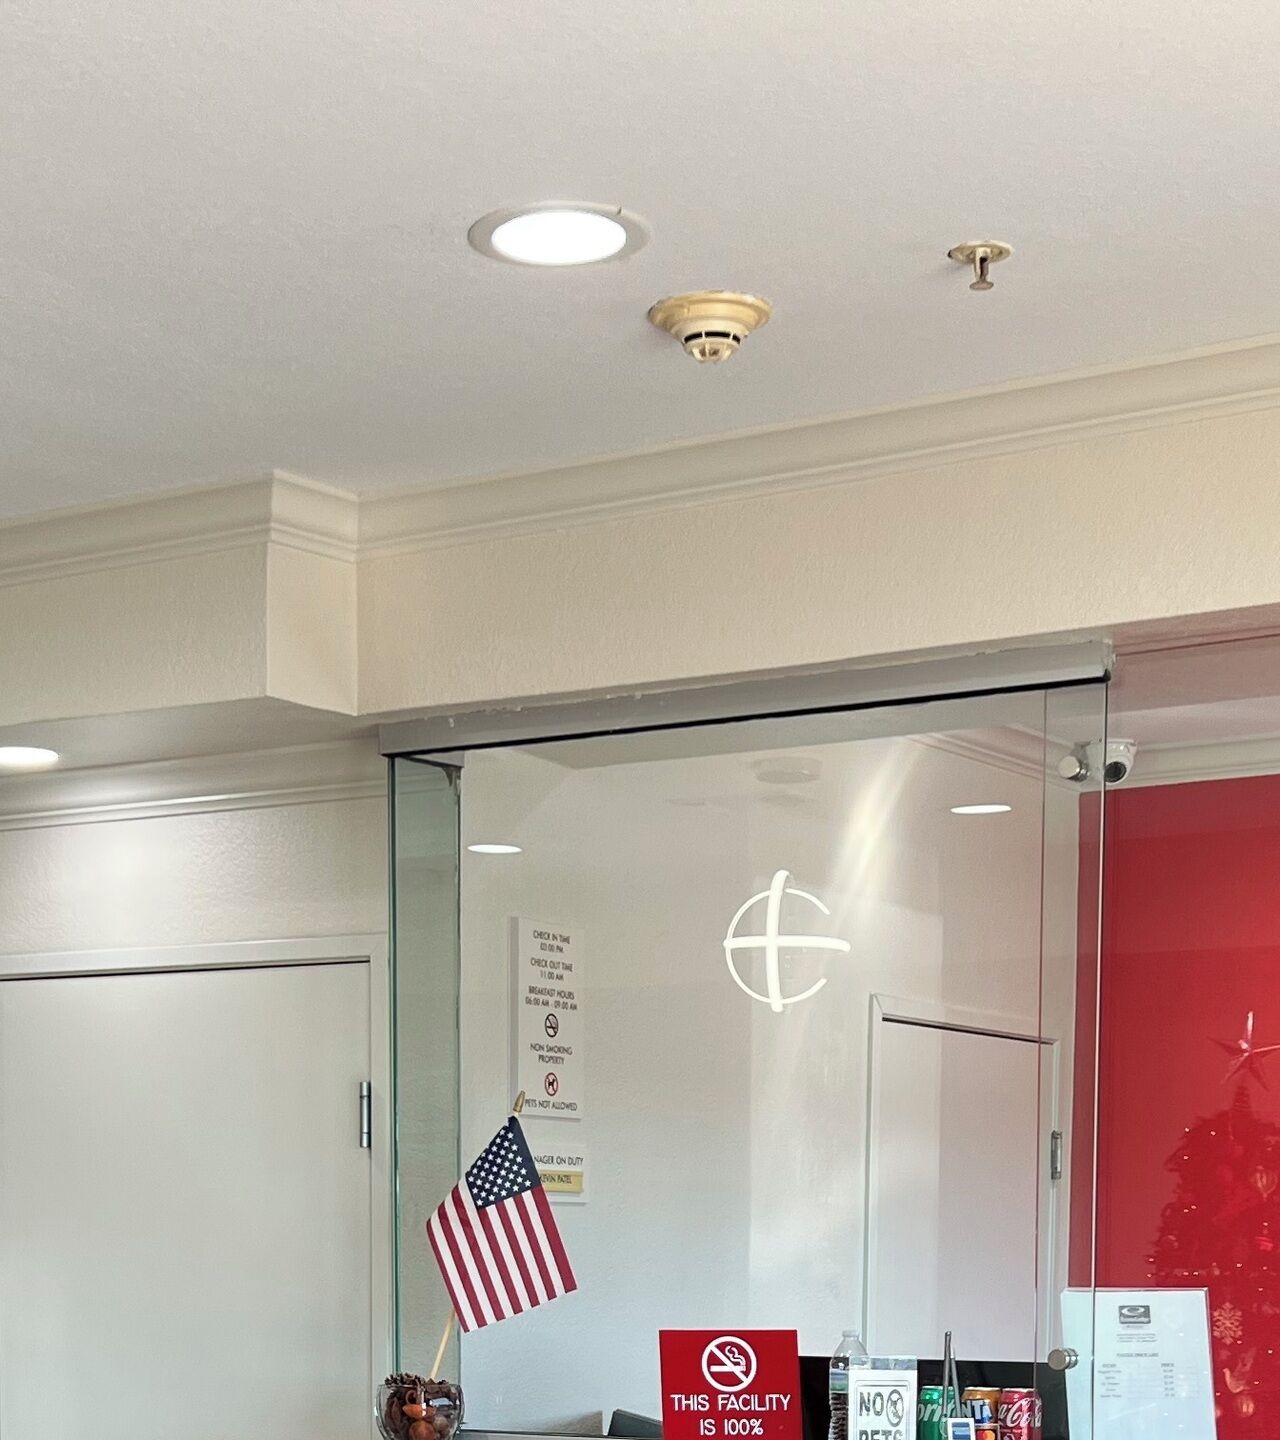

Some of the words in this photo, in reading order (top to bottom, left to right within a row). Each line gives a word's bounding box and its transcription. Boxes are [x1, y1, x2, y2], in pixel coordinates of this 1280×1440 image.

[530, 957, 548, 968] CHECK
[530, 1043, 545, 1051] NON
[546, 1044, 573, 1056] SMOKING
[538, 1055, 565, 1065] PROPERTY
[538, 1101, 551, 1109] NOT
[552, 1102, 578, 1111] ALLOWED
[534, 1155, 555, 1165] NAGER
[556, 1156, 567, 1165] ON
[568, 1157, 584, 1166] DUTY
[671, 1394, 710, 1411] THIS
[718, 1394, 791, 1411] FACILITY
[859, 1391, 884, 1417] NO
[699, 1418, 716, 1436] IS
[724, 1418, 764, 1436] 100%
